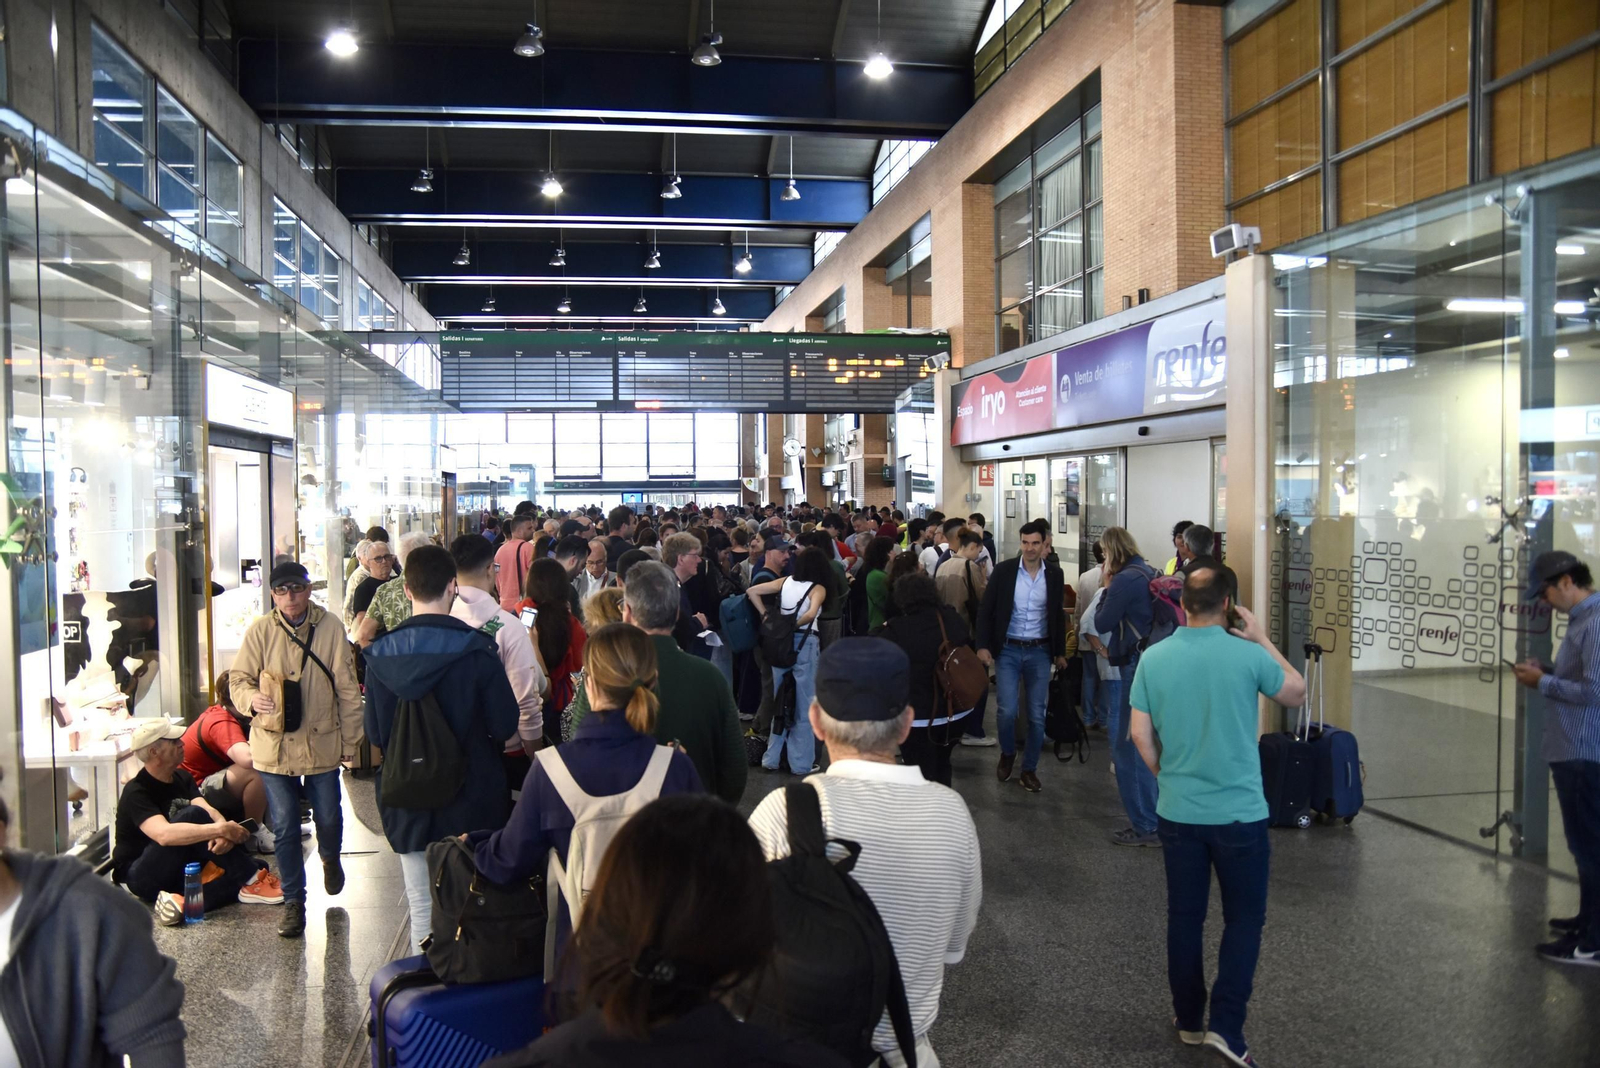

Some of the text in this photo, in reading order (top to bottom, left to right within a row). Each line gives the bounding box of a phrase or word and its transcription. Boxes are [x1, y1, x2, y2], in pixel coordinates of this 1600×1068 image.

[1153, 320, 1227, 388] renfe
[1074, 370, 1093, 386] Venta
[1094, 365, 1103, 381] de
[957, 403, 974, 419] Espacio
[981, 385, 1006, 427] iryo
[1282, 578, 1312, 596] renfe
[1502, 600, 1551, 621] renfe
[1420, 625, 1458, 645] renfe
